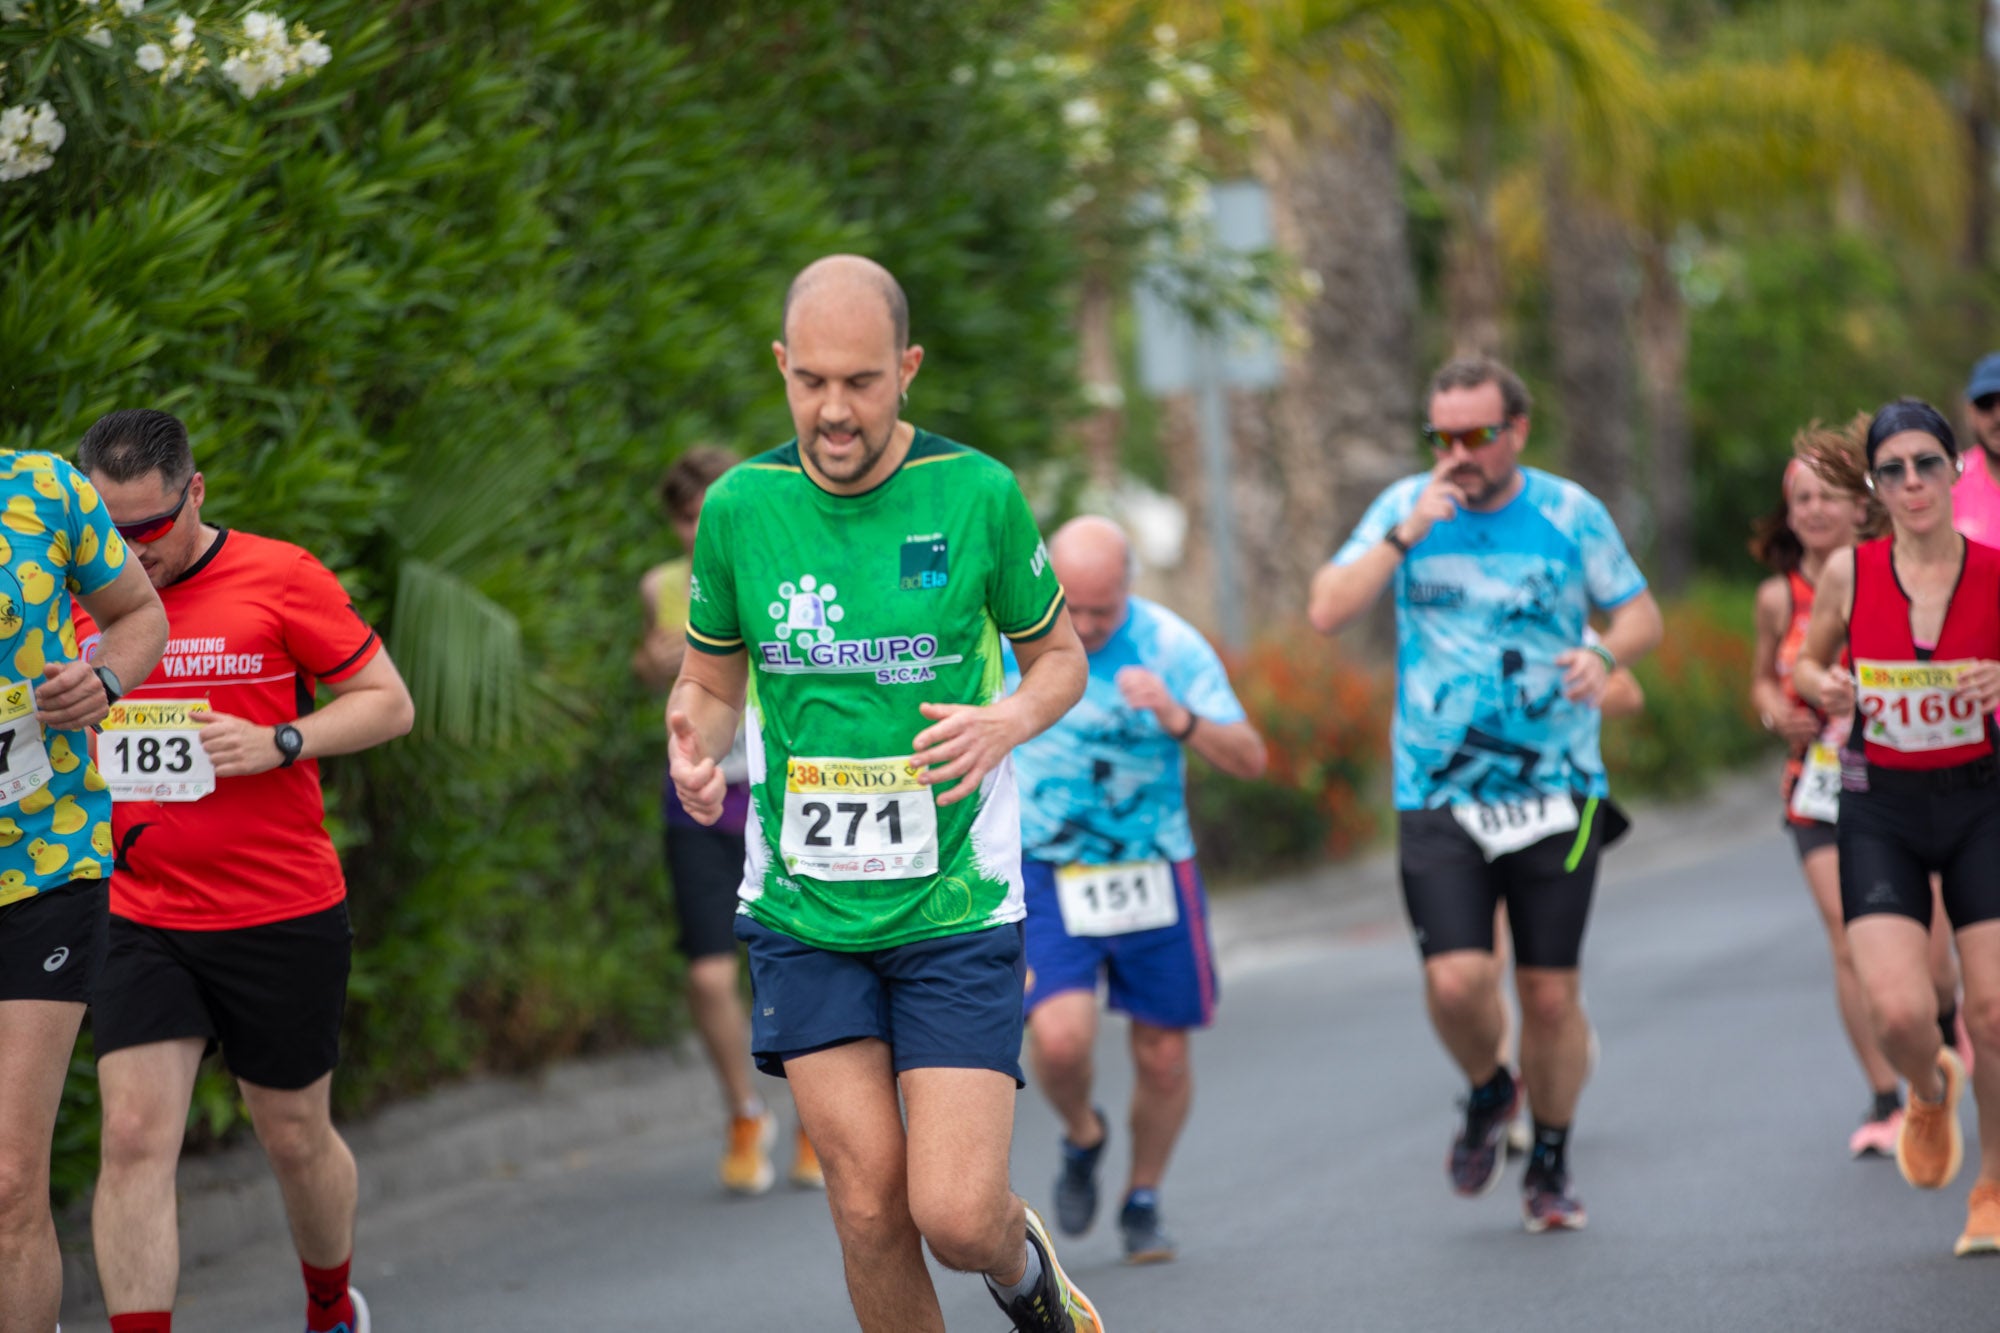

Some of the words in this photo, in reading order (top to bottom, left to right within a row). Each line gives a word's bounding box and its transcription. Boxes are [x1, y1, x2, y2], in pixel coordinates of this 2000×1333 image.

[162, 653, 264, 678] VAMPIROS
[760, 643, 801, 667] EL
[810, 635, 937, 667] GRUPO
[877, 667, 936, 684] S.C.A.
[111, 707, 125, 724] 38
[1862, 693, 1975, 728] 2160
[115, 736, 192, 774] 183
[796, 765, 819, 786] 38
[820, 771, 896, 787] FONDO
[802, 800, 903, 847] 271
[1085, 874, 1148, 914] 151
